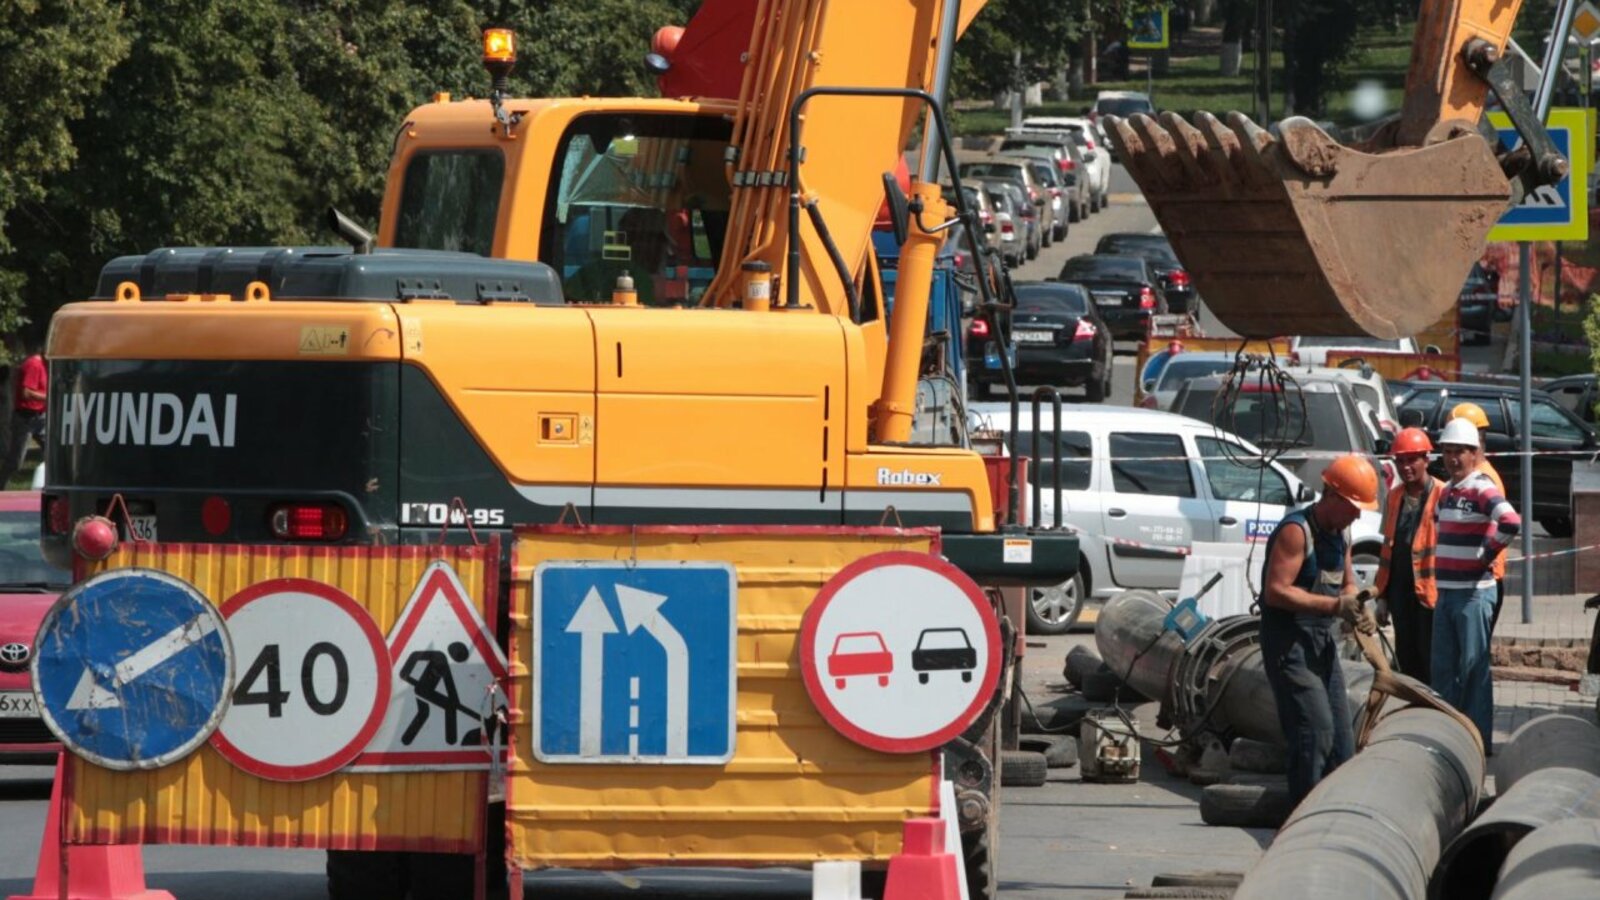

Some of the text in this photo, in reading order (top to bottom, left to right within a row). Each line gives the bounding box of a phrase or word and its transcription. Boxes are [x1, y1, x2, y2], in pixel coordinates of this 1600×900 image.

[61, 391, 238, 448] HYUNDAI
[877, 467, 942, 485] Robex
[232, 641, 349, 718] 40
